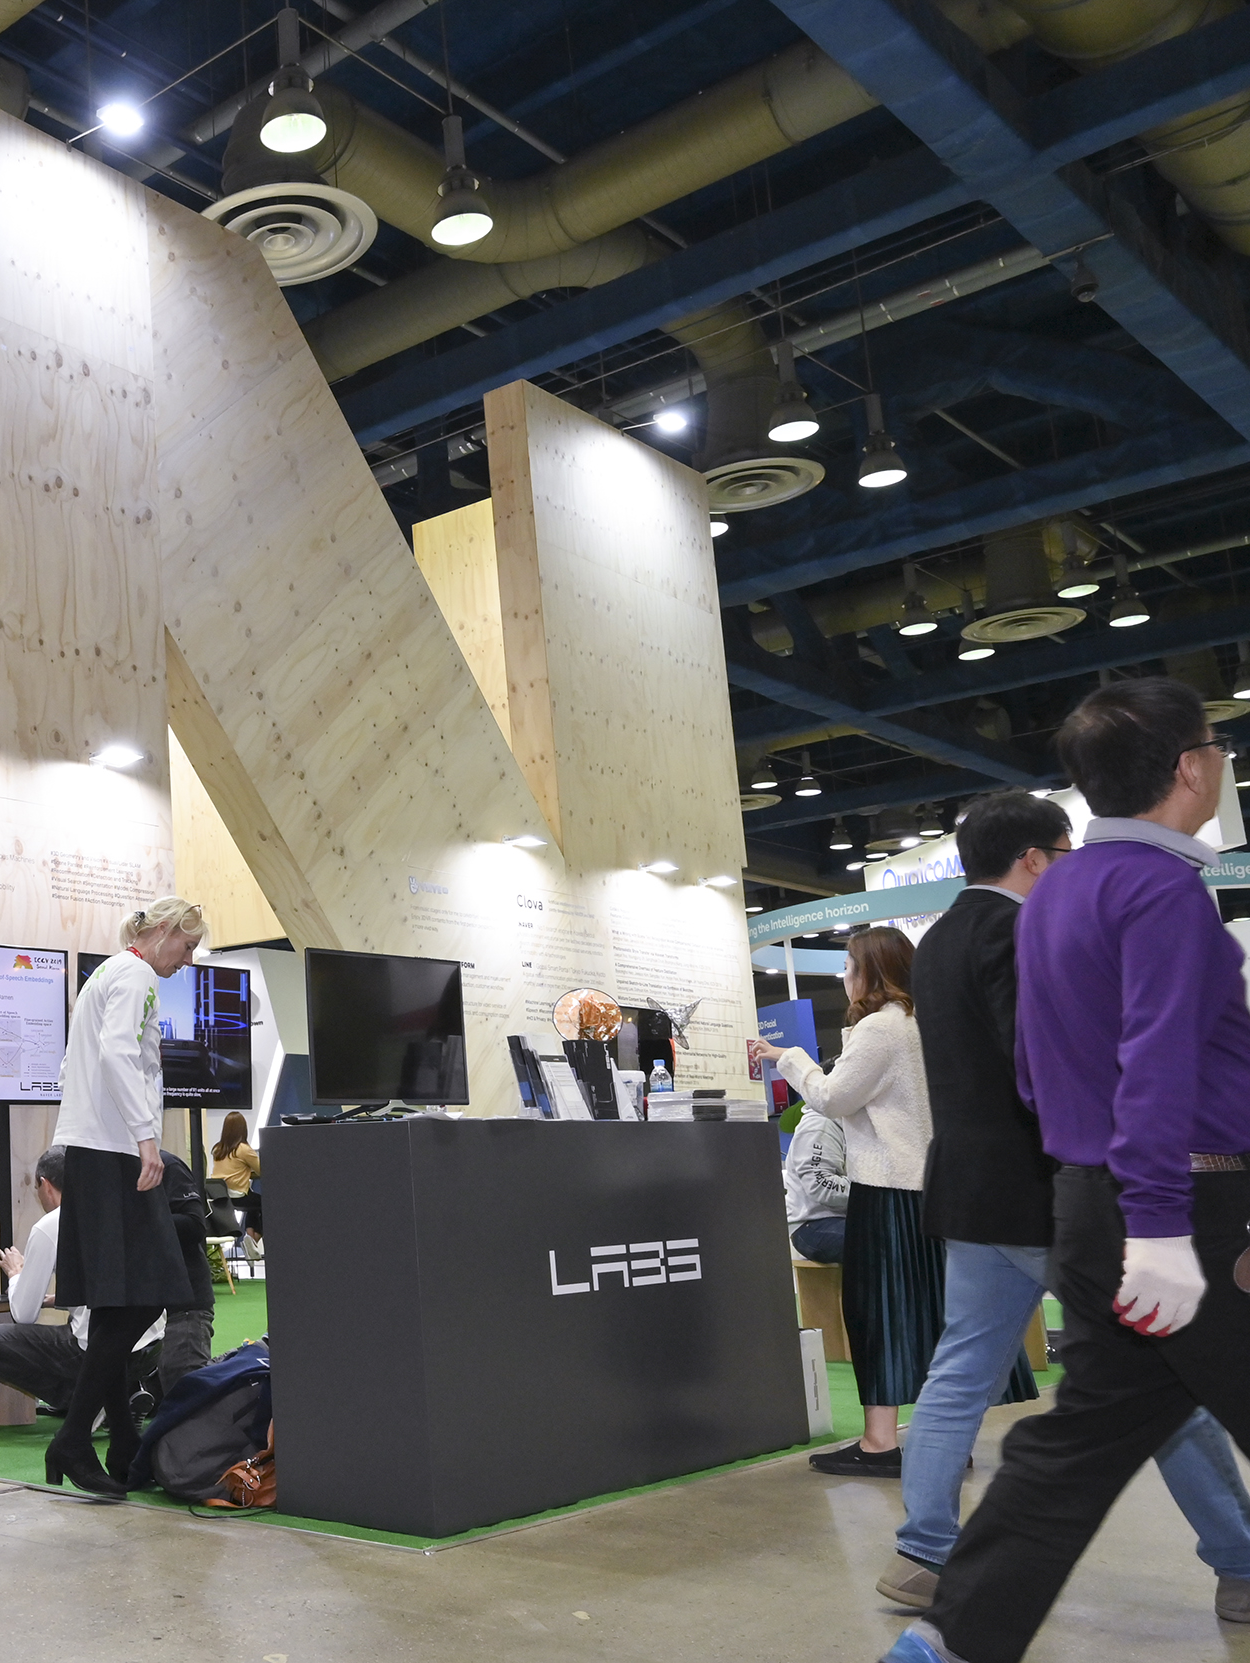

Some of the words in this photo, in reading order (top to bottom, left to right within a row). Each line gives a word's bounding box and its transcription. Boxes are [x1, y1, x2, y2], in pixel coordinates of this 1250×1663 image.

[10, 854, 35, 865] Machines
[70, 887, 90, 895] Language
[91, 890, 113, 898] Processing
[517, 894, 543, 911] Clova
[748, 926, 758, 938] ing
[758, 922, 770, 934] the
[770, 911, 823, 928] Intelligence
[825, 903, 869, 918] horizon
[25, 976, 53, 984] Embeddings
[549, 1238, 702, 1296] LABS
